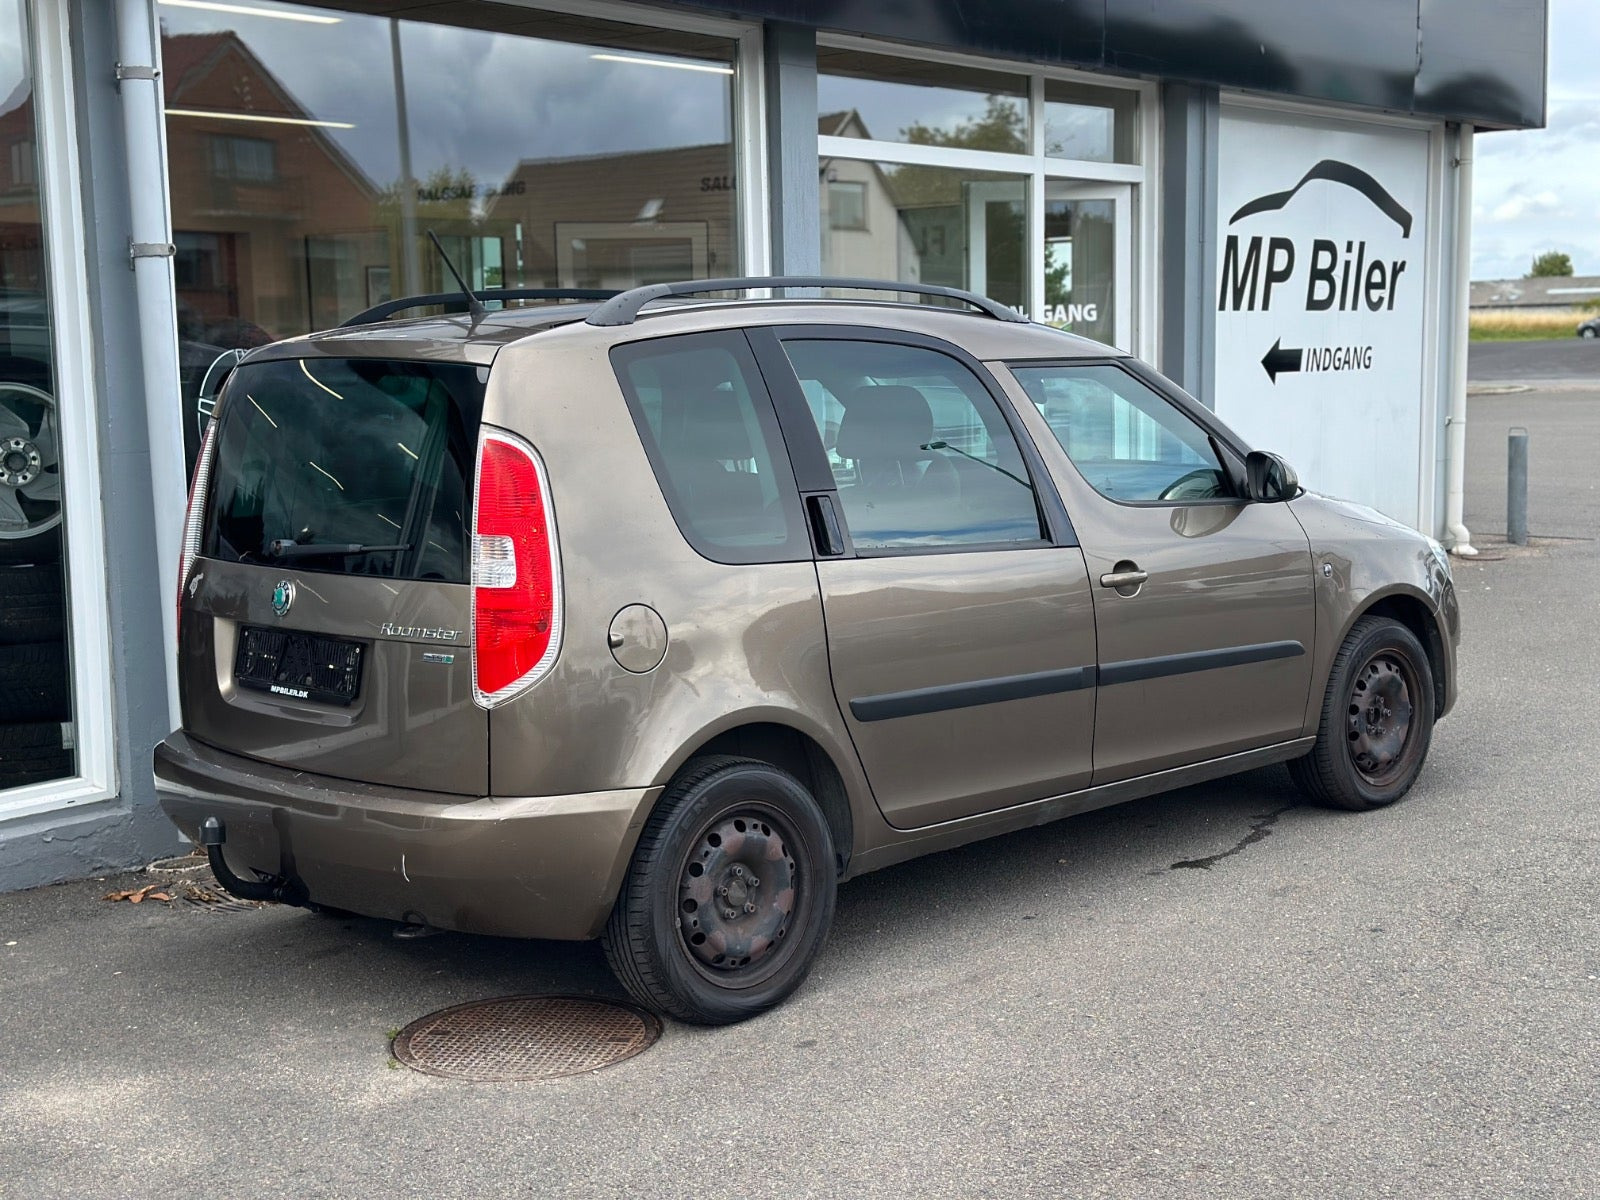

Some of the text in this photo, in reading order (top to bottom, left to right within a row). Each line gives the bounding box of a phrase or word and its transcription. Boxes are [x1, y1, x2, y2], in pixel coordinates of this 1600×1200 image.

[1218, 235, 1407, 312] MP Biler
[1305, 346, 1373, 372] INDGANG
[380, 622, 463, 640] Roomster
[270, 685, 309, 698] MPBILER.DK
